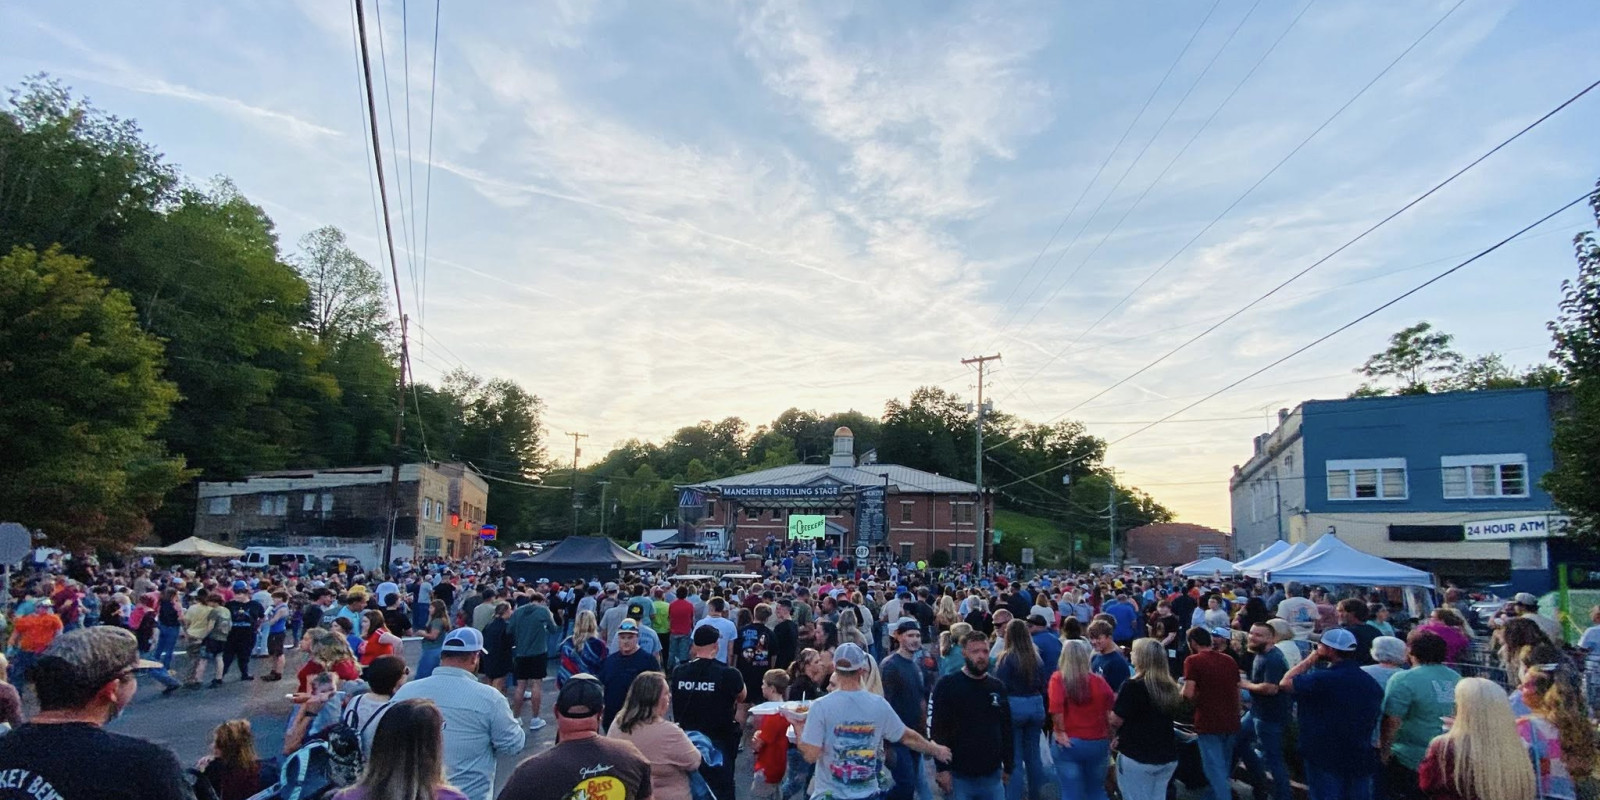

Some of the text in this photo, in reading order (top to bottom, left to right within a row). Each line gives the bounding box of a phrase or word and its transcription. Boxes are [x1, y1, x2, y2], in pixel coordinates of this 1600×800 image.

[796, 519, 824, 534] CREEKERS
[1467, 521, 1545, 535] 24 HOUR ATM
[678, 681, 715, 691] POLICE
